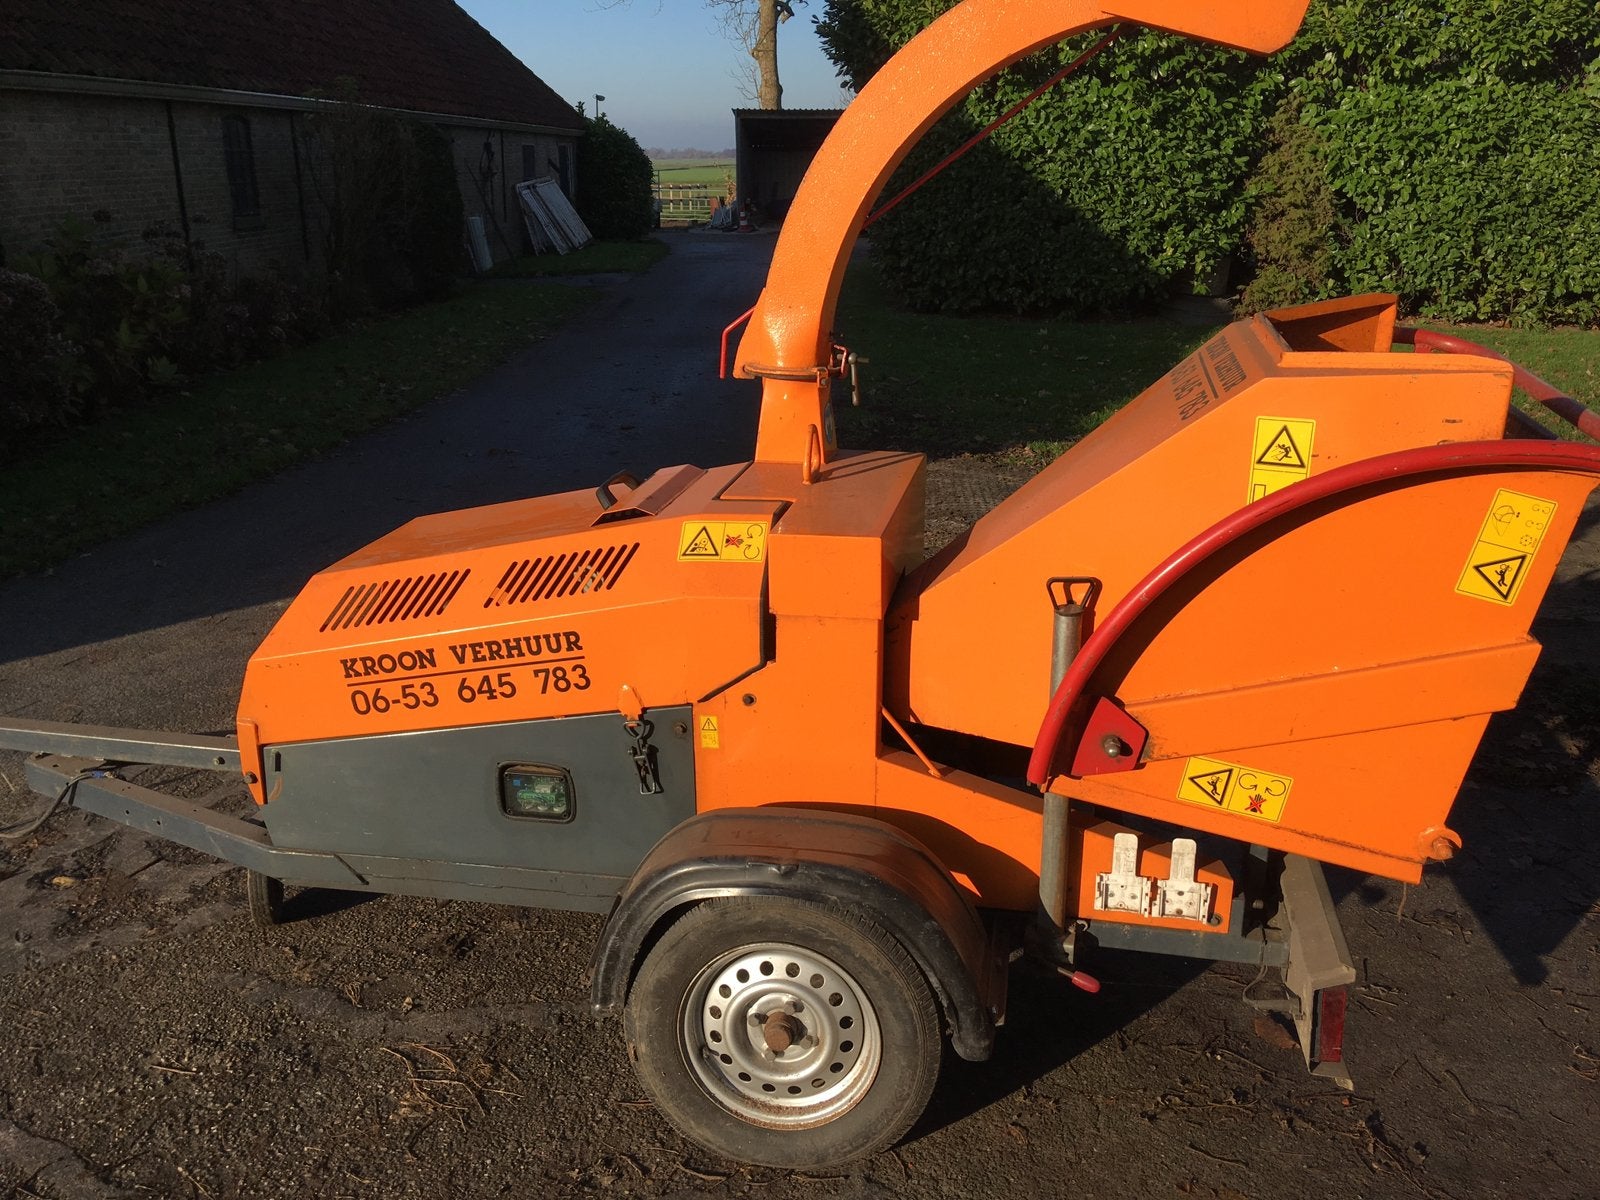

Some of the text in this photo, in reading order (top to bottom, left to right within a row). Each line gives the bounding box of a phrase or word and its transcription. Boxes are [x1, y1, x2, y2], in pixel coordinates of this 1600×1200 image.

[1178, 389, 1210, 421] 783
[339, 631, 584, 679] KROON VERHUUR
[350, 664, 591, 716] 06-53 645 783
